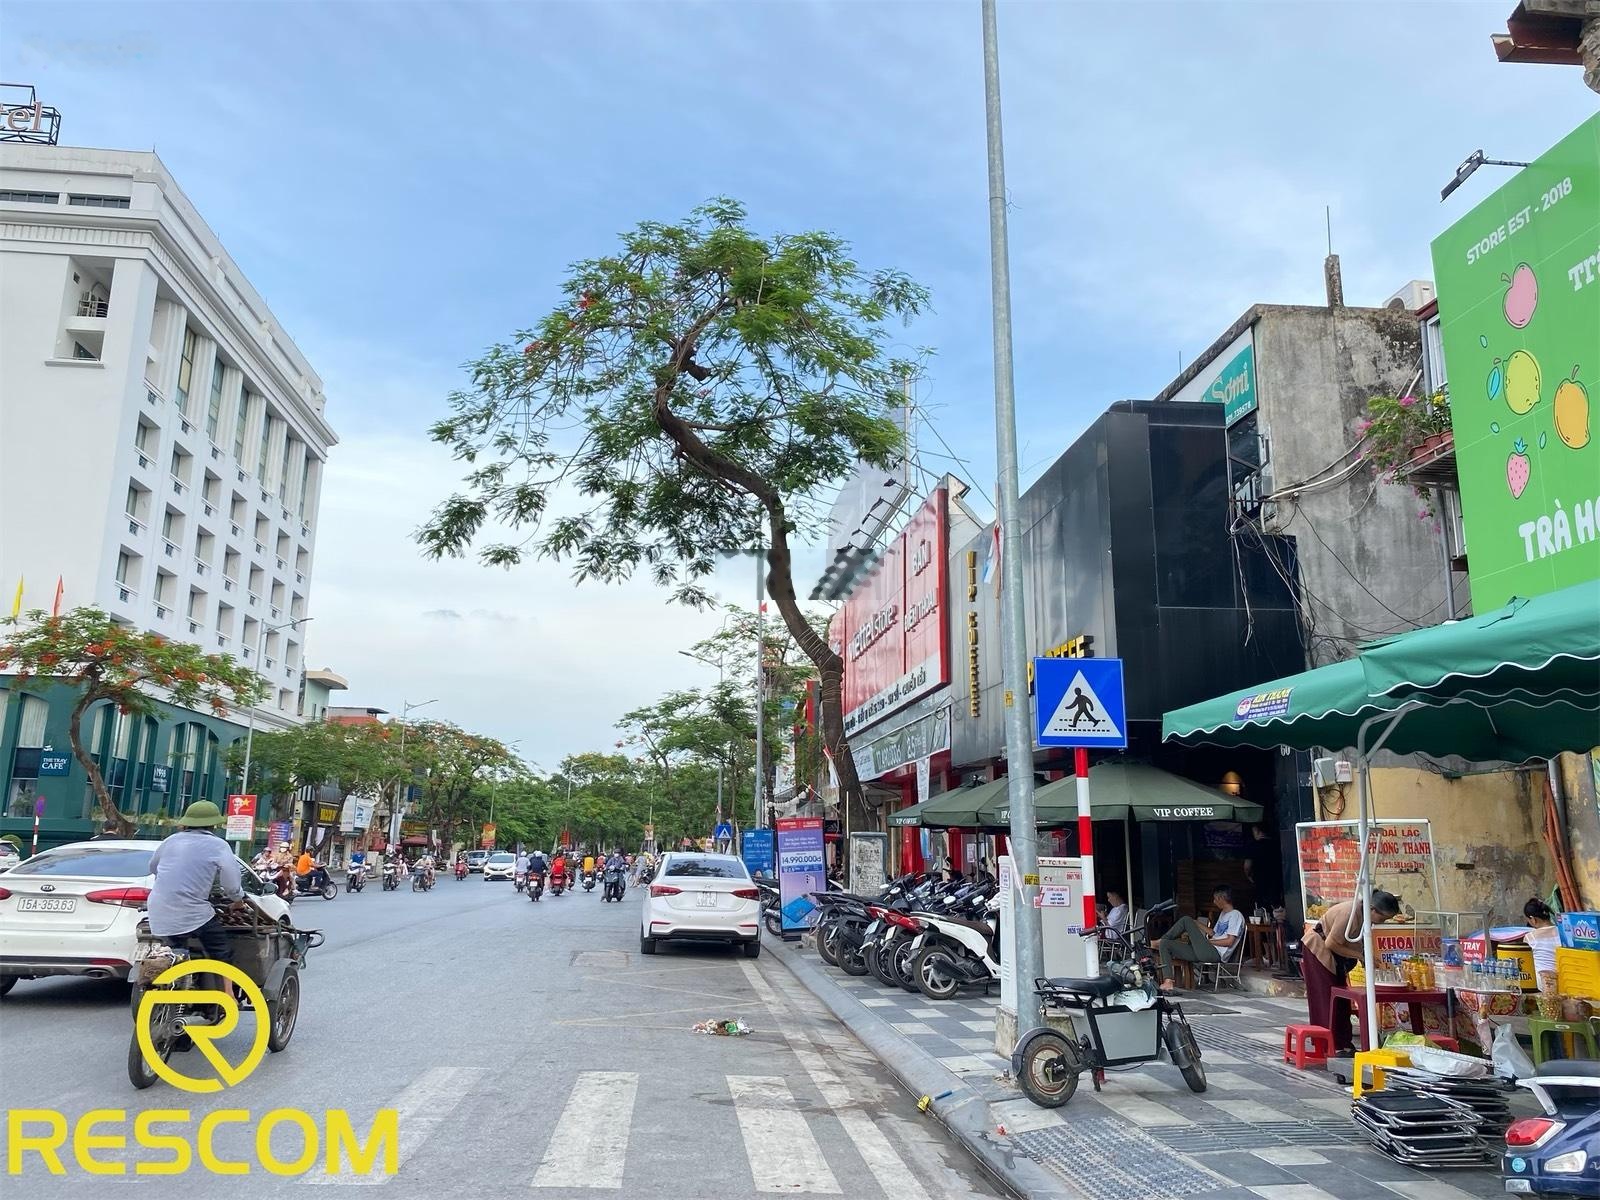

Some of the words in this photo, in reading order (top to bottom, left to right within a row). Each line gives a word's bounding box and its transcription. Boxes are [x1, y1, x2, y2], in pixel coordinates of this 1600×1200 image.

[1466, 225, 1507, 266] STORE
[1507, 205, 1532, 236] EST
[1541, 177, 1573, 212] 2018
[1567, 244, 1600, 292] Tr
[1518, 497, 1573, 563] TRÀ
[1153, 808, 1171, 818] VIP
[1173, 807, 1214, 818] COFFEE
[21, 899, 74, 911] 15A-353.63
[1463, 942, 1481, 951] TRAY
